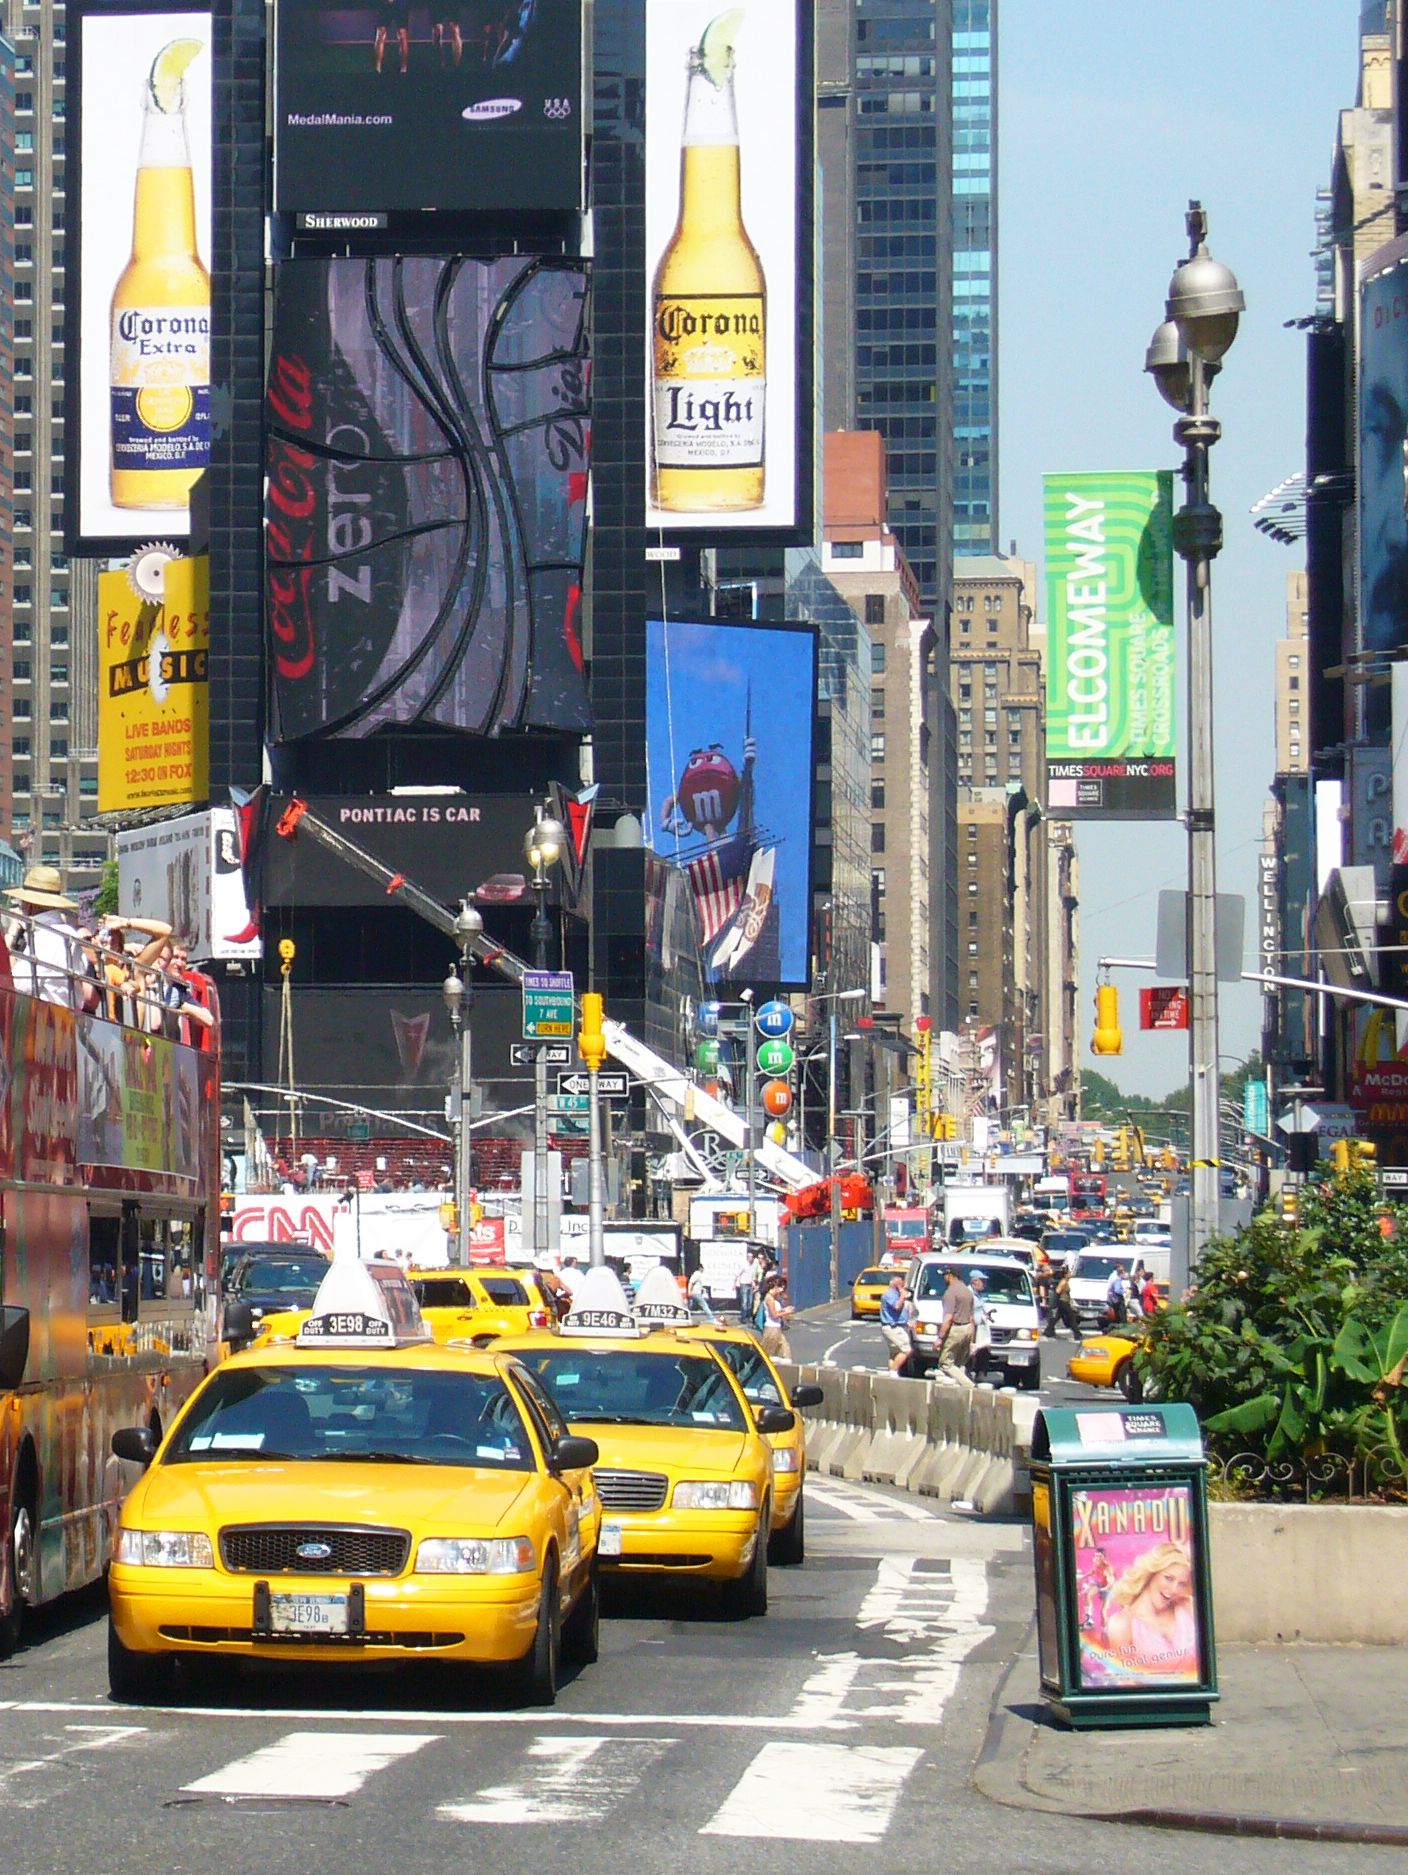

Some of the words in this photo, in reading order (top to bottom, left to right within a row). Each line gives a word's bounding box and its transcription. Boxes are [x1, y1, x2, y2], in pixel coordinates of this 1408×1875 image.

[469, 104, 515, 114] SAMSUNG
[287, 113, 392, 125] MedalMania.com
[305, 213, 378, 228] SHERWOOD
[119, 311, 209, 344] Corona
[659, 305, 760, 346] Corona
[139, 339, 197, 355] Extra
[666, 385, 754, 430] Light
[327, 424, 372, 603] zero
[112, 653, 207, 692] MUSIC
[125, 723, 149, 740] LIVE
[151, 718, 192, 737] BANDS
[125, 743, 162, 762] SATURDAY
[163, 740, 192, 758] NIGHTS
[125, 767, 155, 784] 12:30
[169, 762, 192, 779] FOX
[340, 808, 417, 823] PONTIAC
[422, 808, 442, 822] IS
[445, 808, 481, 822] CAR
[1260, 857, 1277, 992] WELLINGTON
[767, 1013, 782, 1026] m
[767, 1052, 783, 1065] m
[569, 1080, 589, 1089] ONE
[598, 1080, 619, 1089] WAY
[582, 1312, 617, 1326] 9E46
[644, 1305, 675, 1318] 7M32
[304, 1327, 324, 1335] DUTY
[365, 1327, 386, 1335] DUTY
[307, 1320, 323, 1328] OFF
[368, 1320, 383, 1328] OFF
[329, 1316, 364, 1333] 3E98
[1124, 1420, 1161, 1428] SQUARE
[1076, 1497, 1188, 1549] XANADU
